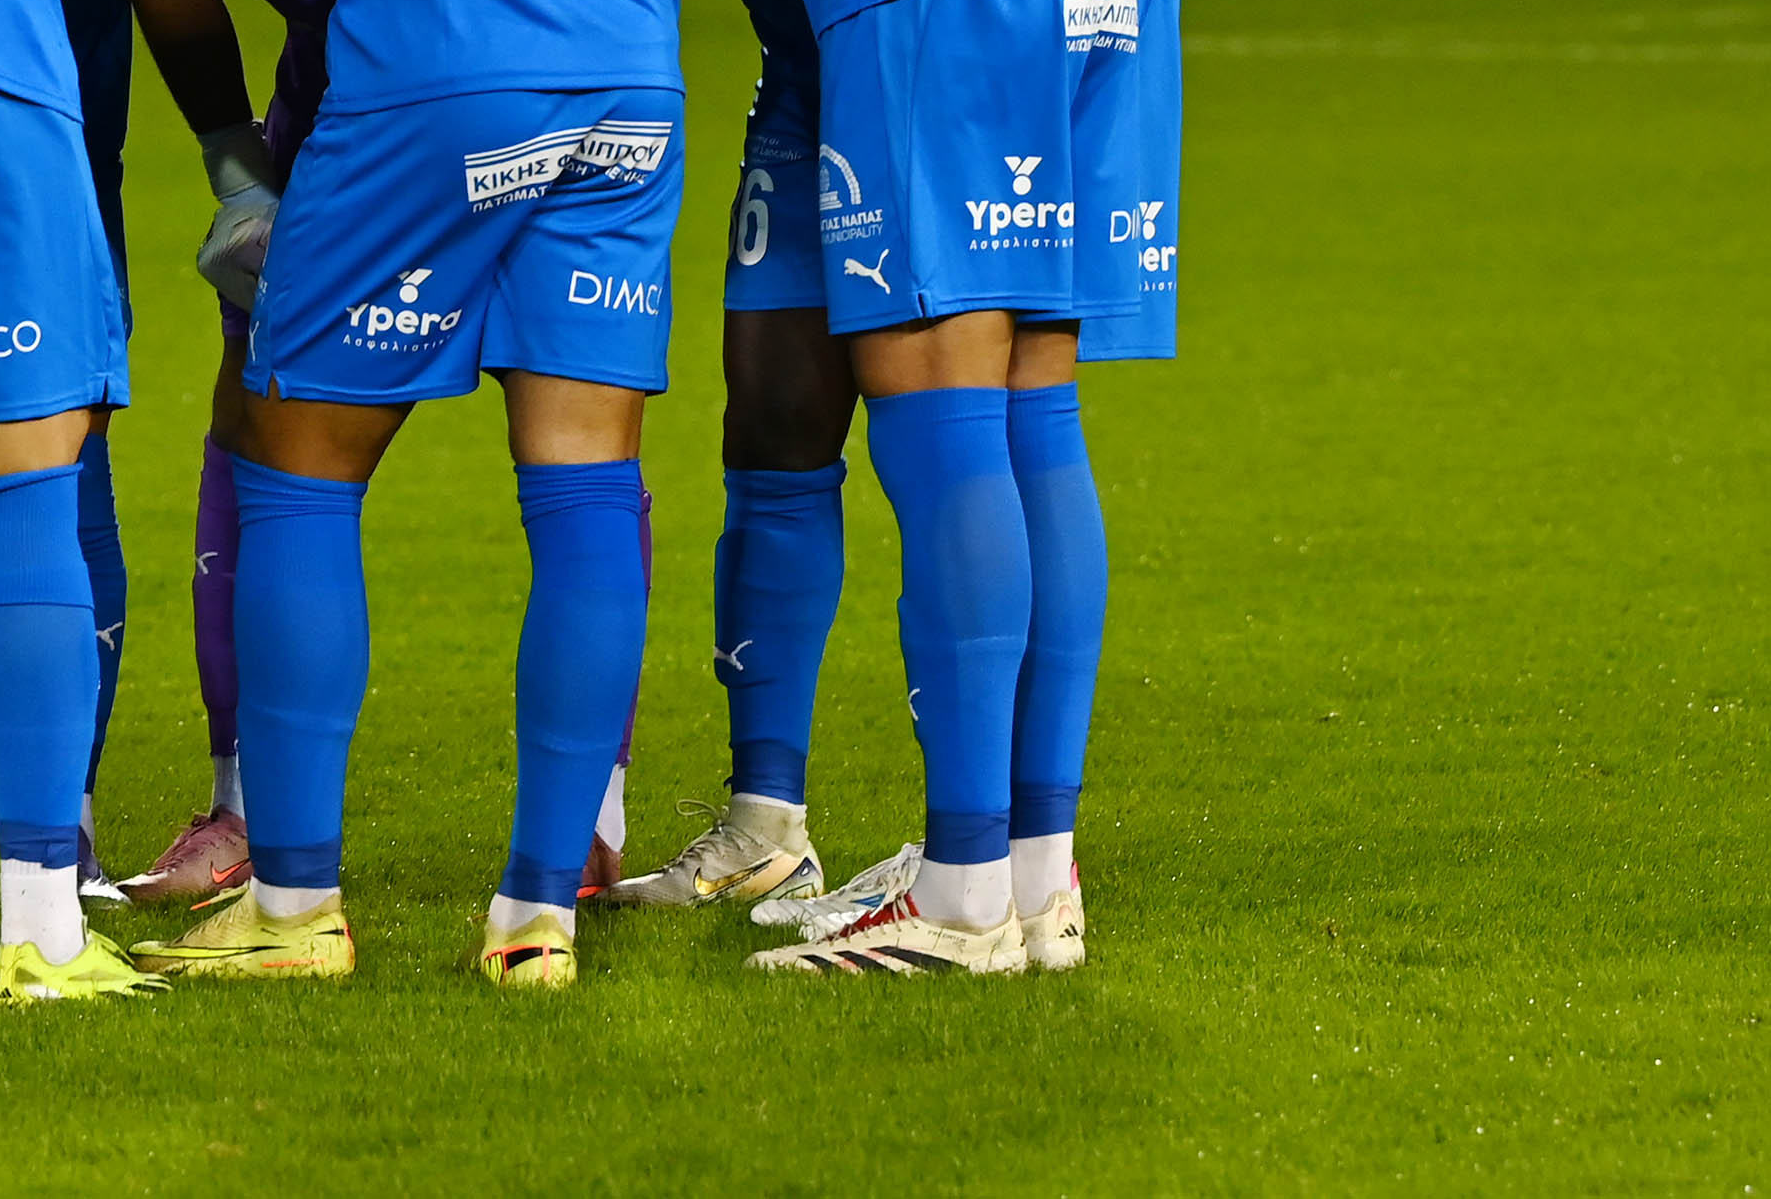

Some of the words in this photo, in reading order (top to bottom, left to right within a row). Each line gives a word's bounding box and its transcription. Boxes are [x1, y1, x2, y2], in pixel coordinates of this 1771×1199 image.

[731, 168, 774, 266] 6
[965, 200, 1074, 236] Ypera
[568, 270, 662, 315] DIMC
